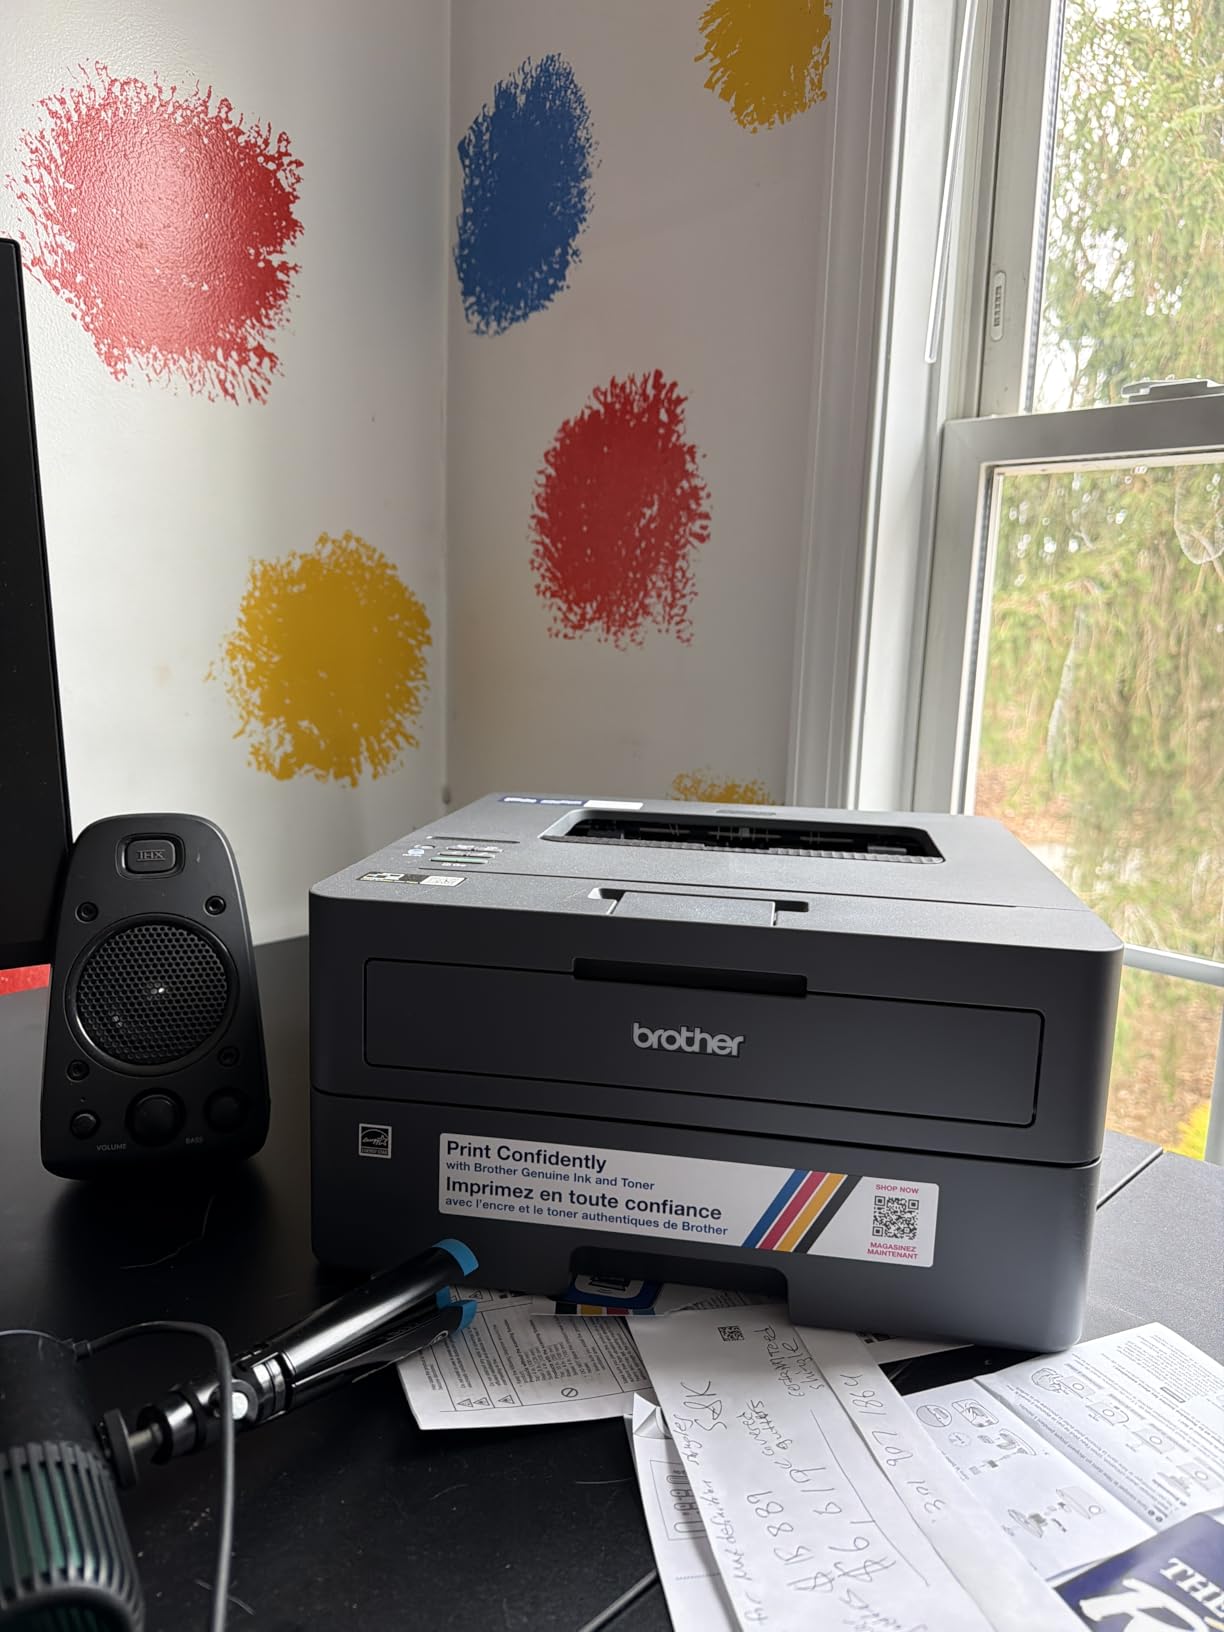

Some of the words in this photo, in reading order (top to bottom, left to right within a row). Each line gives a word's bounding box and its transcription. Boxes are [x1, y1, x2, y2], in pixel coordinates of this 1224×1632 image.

[136, 848, 166, 862] THX
[632, 1022, 745, 1057] brother
[96, 1143, 128, 1152] VOLUME
[447, 1140, 492, 1159] Print
[496, 1144, 607, 1174] Confidently
[446, 1161, 471, 1172] with
[474, 1162, 518, 1176] Brother
[521, 1167, 570, 1182] Genuine
[573, 1173, 592, 1184] Ink
[595, 1177, 617, 1187] and
[621, 1178, 655, 1190] Toner
[446, 1176, 535, 1200] Imprimez
[539, 1189, 562, 1203] en
[568, 1190, 619, 1209] toute
[624, 1198, 722, 1220] confiance
[875, 1184, 898, 1192] SHOP
[900, 1186, 919, 1194] NOW
[445, 1197, 473, 1208] avec
[476, 1199, 516, 1212] l'encre
[518, 1204, 531, 1214] et
[533, 1205, 544, 1215] le
[547, 1207, 578, 1219] toner
[581, 1211, 660, 1228] authentiques
[663, 1219, 678, 1230] de
[682, 1221, 729, 1236] Brother
[867, 1249, 918, 1260] MAINTENANT
[870, 1242, 917, 1253] MAGASINEZ
